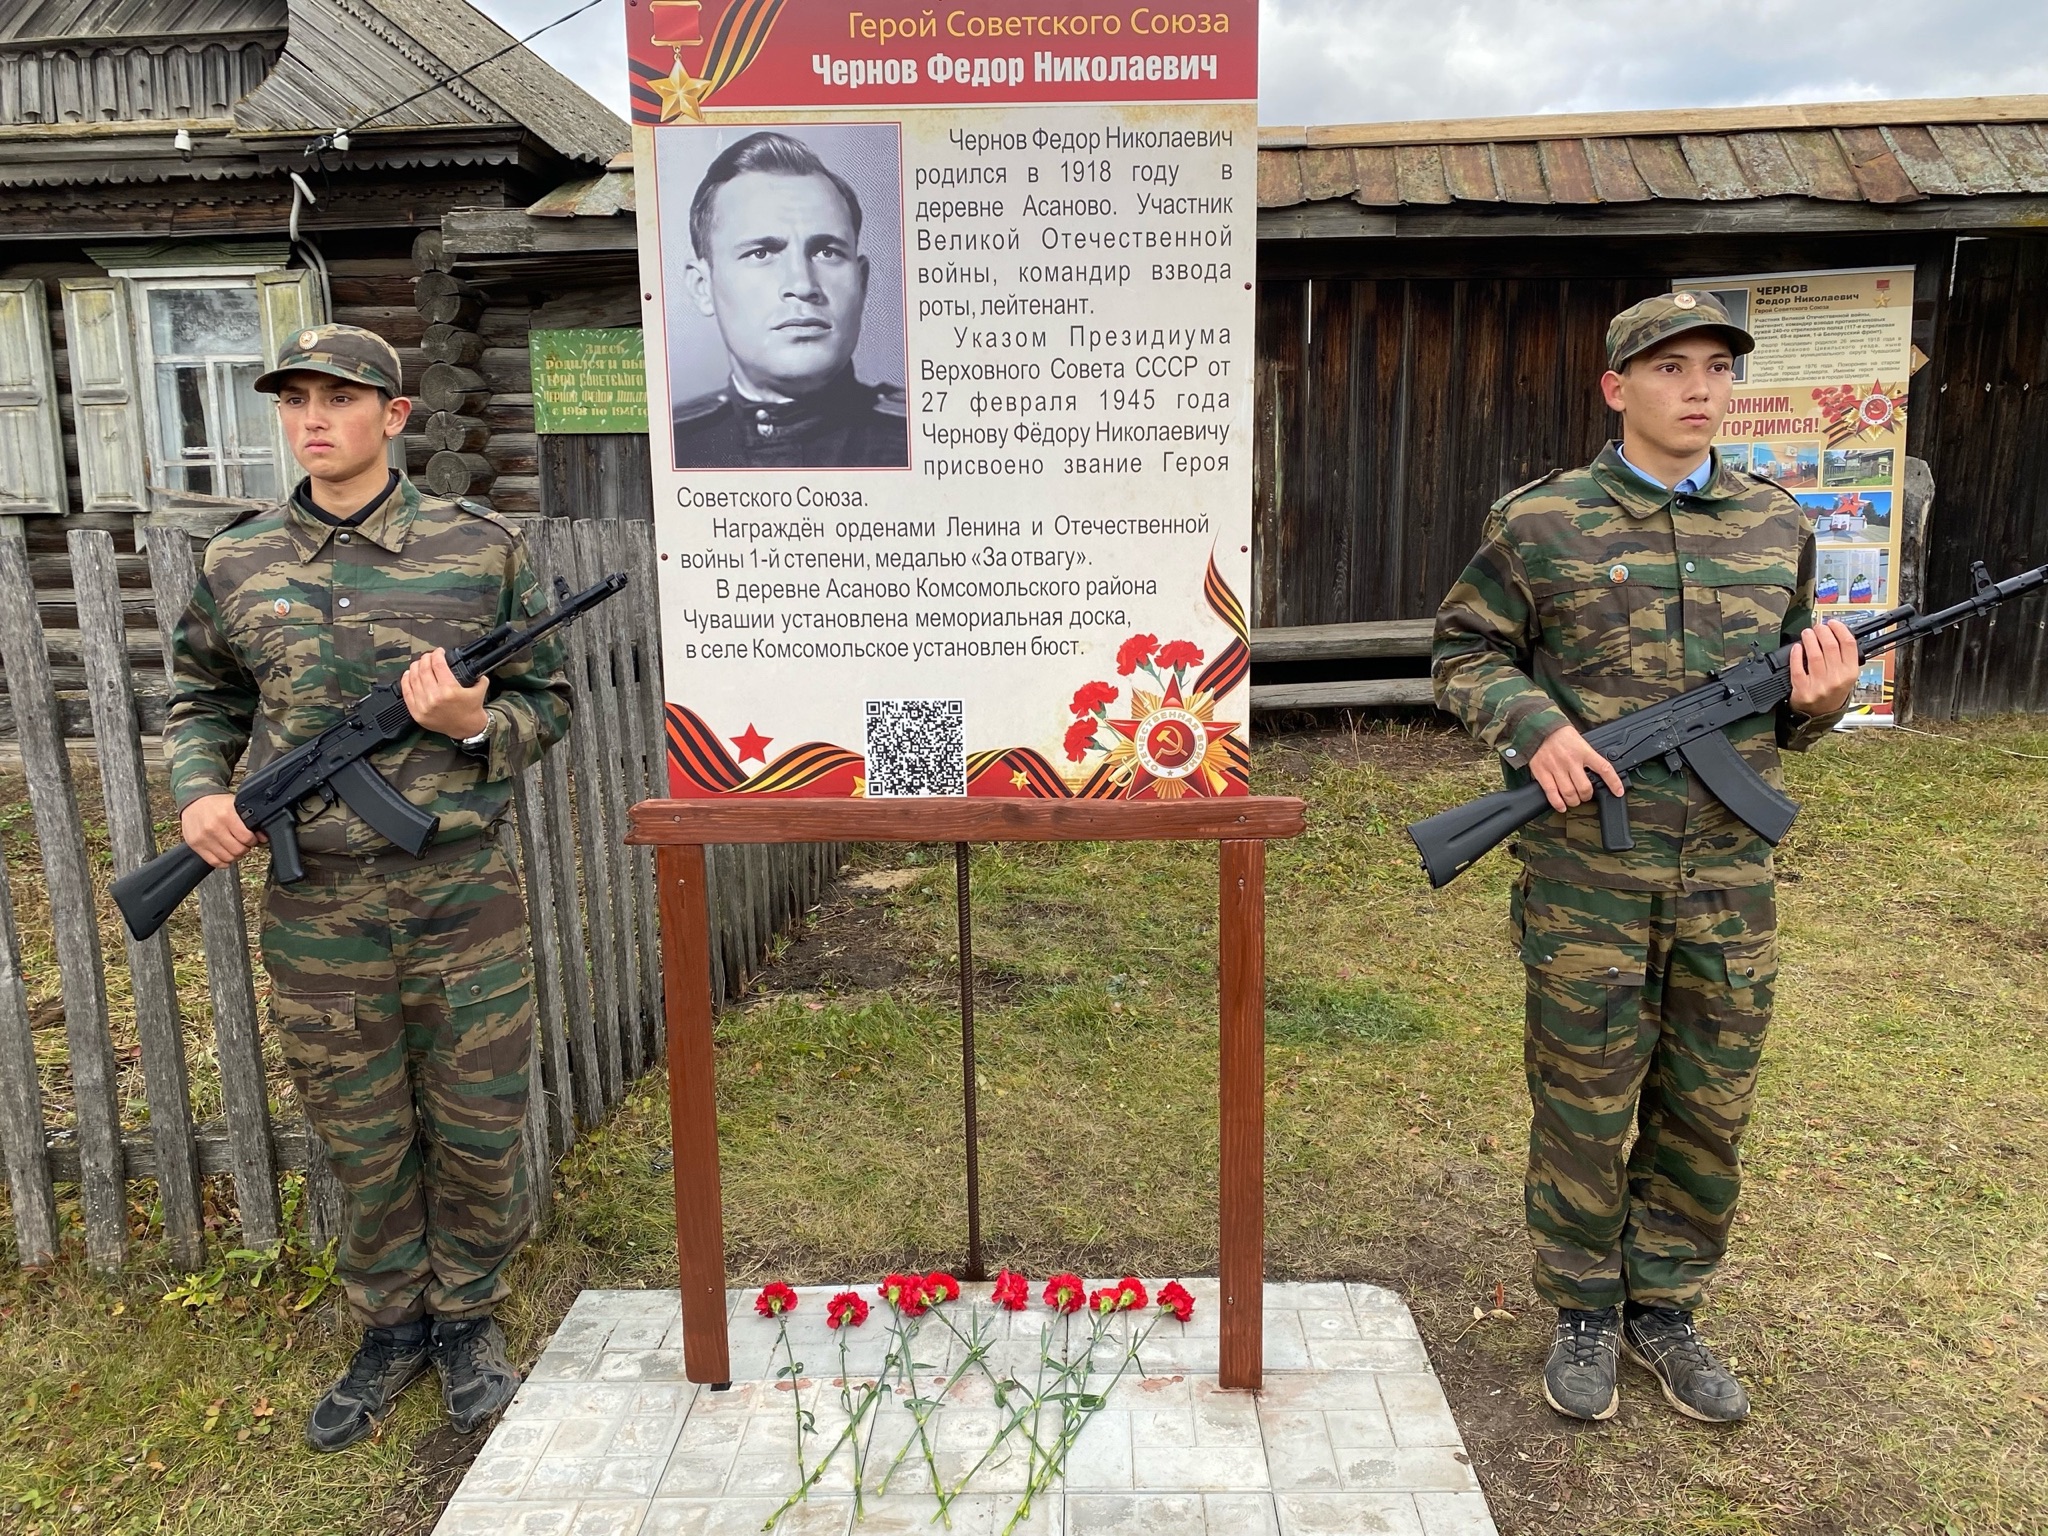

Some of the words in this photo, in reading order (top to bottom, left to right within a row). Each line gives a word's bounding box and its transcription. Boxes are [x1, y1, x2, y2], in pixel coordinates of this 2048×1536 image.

[849, 10, 937, 45] Герой
[947, 10, 1121, 38] Советского
[1130, 8, 1229, 34] Союза
[812, 54, 918, 88] Чернов
[927, 52, 1024, 87] Федор
[1034, 51, 1218, 83] Николаевич
[949, 128, 1027, 156] Чернов
[1032, 127, 1101, 154] Федор
[1107, 126, 1233, 149] Николаевич
[915, 166, 1008, 189] родился
[1028, 166, 1039, 183] в
[1060, 160, 1112, 183] 1918
[1132, 164, 1180, 187] году
[1221, 163, 1233, 180] в
[916, 200, 1004, 223] деревне
[1022, 194, 1117, 217] Асаново.
[1137, 193, 1233, 215] Участник
[917, 228, 1020, 251] Великой
[1041, 225, 1233, 249] Отечественной
[918, 262, 998, 286] войны,
[1019, 263, 1131, 290] командир
[1152, 262, 1232, 283] взвода
[1755, 297, 1791, 306] Федор
[1794, 293, 1859, 304] Николаевич
[1757, 284, 1808, 296] ЧЕРНОВ
[919, 299, 976, 321] роты,
[980, 294, 1094, 316] лейтенант.
[953, 326, 1047, 348] Указом
[1070, 325, 1231, 351] Президиума
[921, 359, 1041, 385] Верховного
[1050, 357, 1125, 380] Совета
[1135, 356, 1198, 378] СССР
[1208, 360, 1231, 377] от
[921, 391, 948, 413] 27
[970, 391, 1077, 416] февраля
[1099, 388, 1156, 410] 1945
[1177, 391, 1230, 412] года
[1727, 396, 1794, 414] ОМНИМ,
[922, 423, 1009, 448] Чернову
[1013, 422, 1090, 448] Фёдору
[1096, 421, 1230, 445] Николаевичу
[1722, 417, 1819, 437] ГОРДИМСЯ!
[924, 458, 1044, 480] присвоено
[1063, 457, 1142, 474] звание
[1162, 451, 1229, 477] Героя
[677, 486, 792, 508] Советского
[796, 486, 868, 507] Союза.
[712, 517, 825, 542] Награждён
[835, 521, 935, 542] орденами
[946, 516, 1020, 537] Ленина
[1032, 520, 1043, 536] и
[1054, 513, 1209, 536] Отечественной
[681, 548, 744, 568] войны
[750, 548, 780, 568] 1-й
[784, 552, 871, 570] степени,
[875, 550, 967, 571] медалью
[971, 546, 1007, 566] «За
[1010, 550, 1093, 571] отвагу».
[716, 578, 730, 598] В
[735, 582, 820, 603] деревне
[826, 578, 910, 598] Асаново
[916, 577, 1080, 598] Комсомольского
[1086, 576, 1157, 600] района
[683, 609, 775, 634] Чувашии
[781, 612, 908, 633] установлена
[915, 610, 1063, 631] мемориальная
[1069, 609, 1131, 629] доска,
[686, 644, 697, 659] в
[701, 643, 748, 659] селе
[753, 638, 909, 658] Комсомольское
[913, 641, 1026, 662] установлен
[1031, 636, 1085, 655] бюст.
[1138, 711, 1200, 772] ОТЕЧЕСТВЕННАЯ
